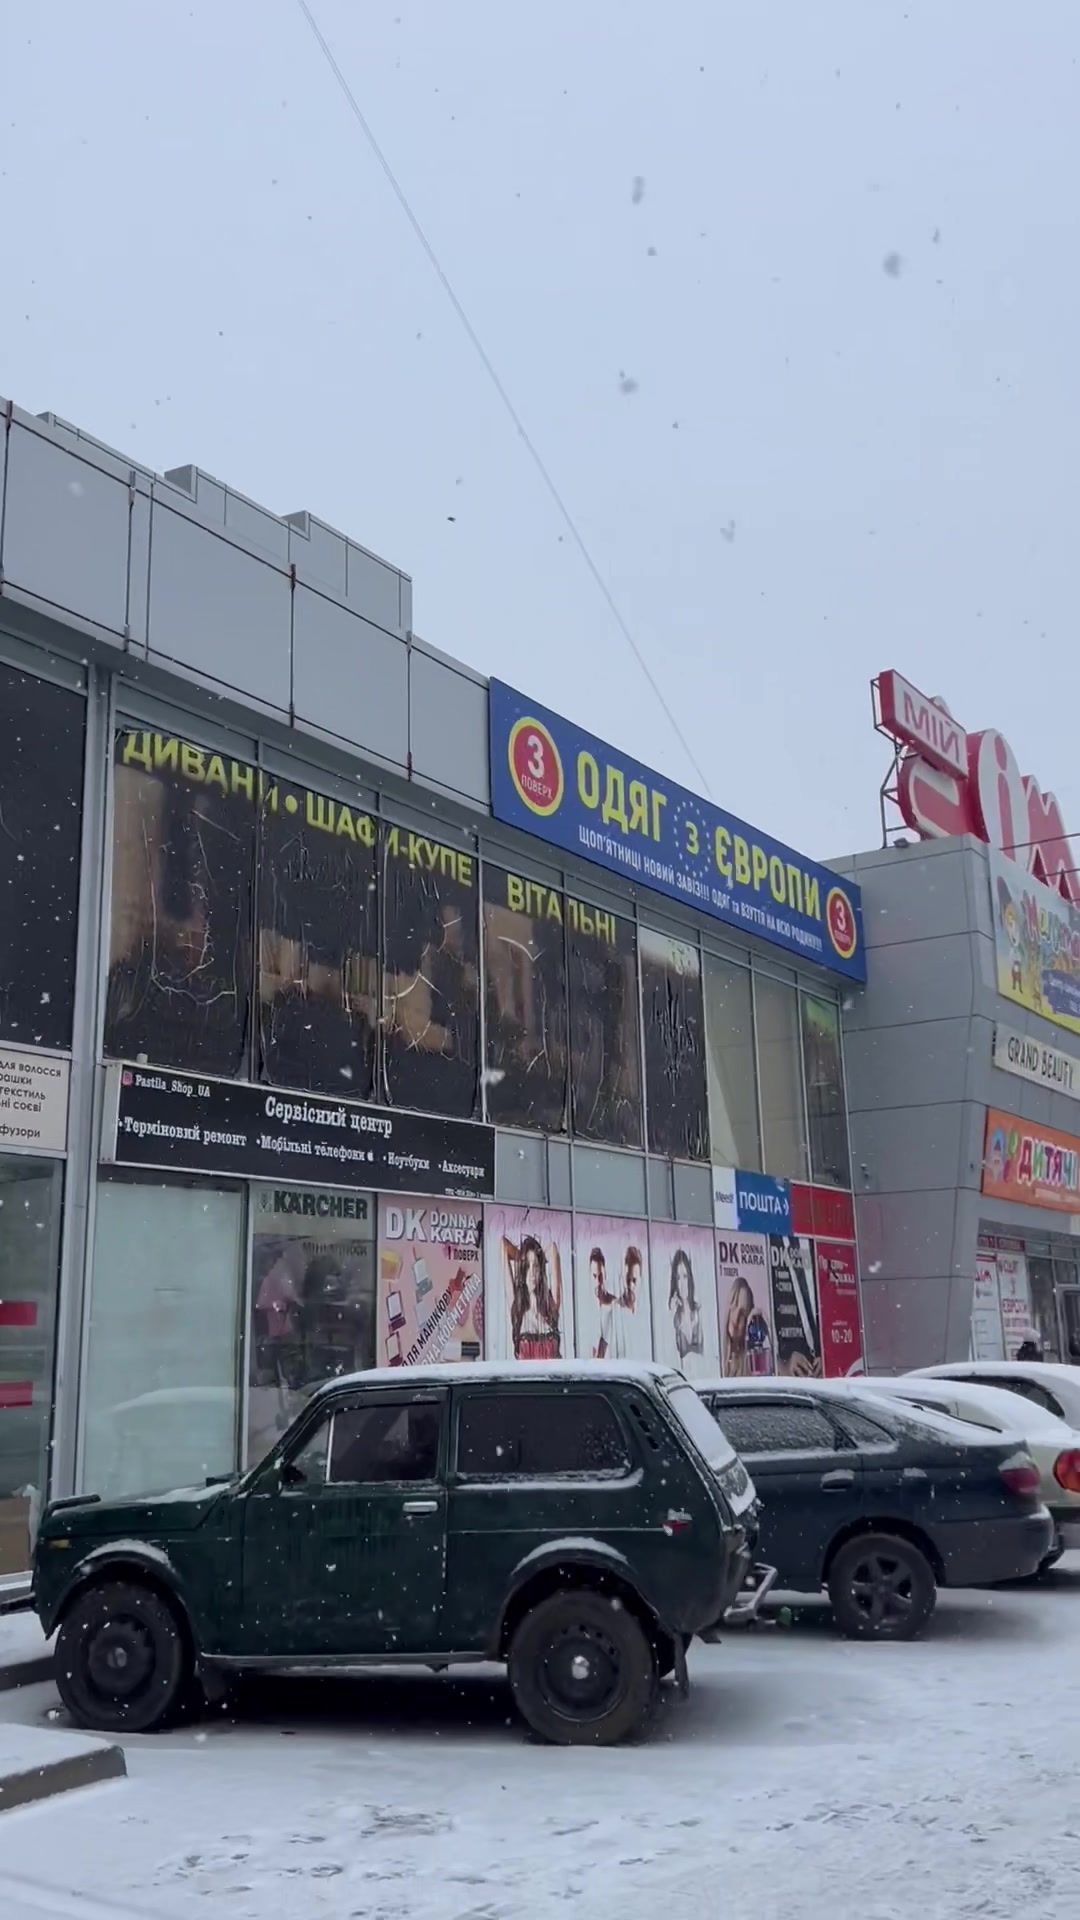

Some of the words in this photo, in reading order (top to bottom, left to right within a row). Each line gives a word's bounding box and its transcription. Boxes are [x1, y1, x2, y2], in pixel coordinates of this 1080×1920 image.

[527, 734, 545, 779] 3
[123, 731, 278, 812] ДИВАНИ
[521, 774, 553, 799] ПОВЕРХ
[577, 751, 667, 842] ОДЯГ
[714, 826, 822, 921] ЄВРОПИ
[643, 856, 675, 885] НОВИЙ
[676, 871, 710, 901] ЗАВІЗ!!!
[506, 874, 617, 943] ВІТАЛЬНІ
[835, 900, 847, 931] 3
[18, 1063, 62, 1077] волосся
[1007, 1036, 1039, 1071] GRAND
[1041, 1050, 1074, 1090] BEAUTY
[135, 1074, 211, 1097] Pastila_Shop_UA
[0, 1098, 10, 1108] ні
[13, 1101, 42, 1112] соєві
[265, 1096, 347, 1128] Сервісний
[350, 1114, 393, 1139] центр
[124, 1116, 201, 1141] Терміновий
[203, 1130, 248, 1146] ремонт
[261, 1134, 312, 1155] Мобільні
[314, 1144, 365, 1162] телефони
[388, 1151, 430, 1172] Ноутбуки
[442, 1160, 485, 1179] Аксесуари
[739, 1191, 783, 1215] ПОШТА
[386, 1206, 427, 1242] DK
[430, 1211, 477, 1229] DONNA
[430, 1226, 477, 1245] KARA
[454, 1248, 479, 1262] ПОВЕРХ
[718, 1241, 740, 1264] DK
[741, 1254, 765, 1266] KARA
[417, 1286, 454, 1350] МАНІКЮРУ
[437, 1271, 482, 1344] КОСМЕТИКА
